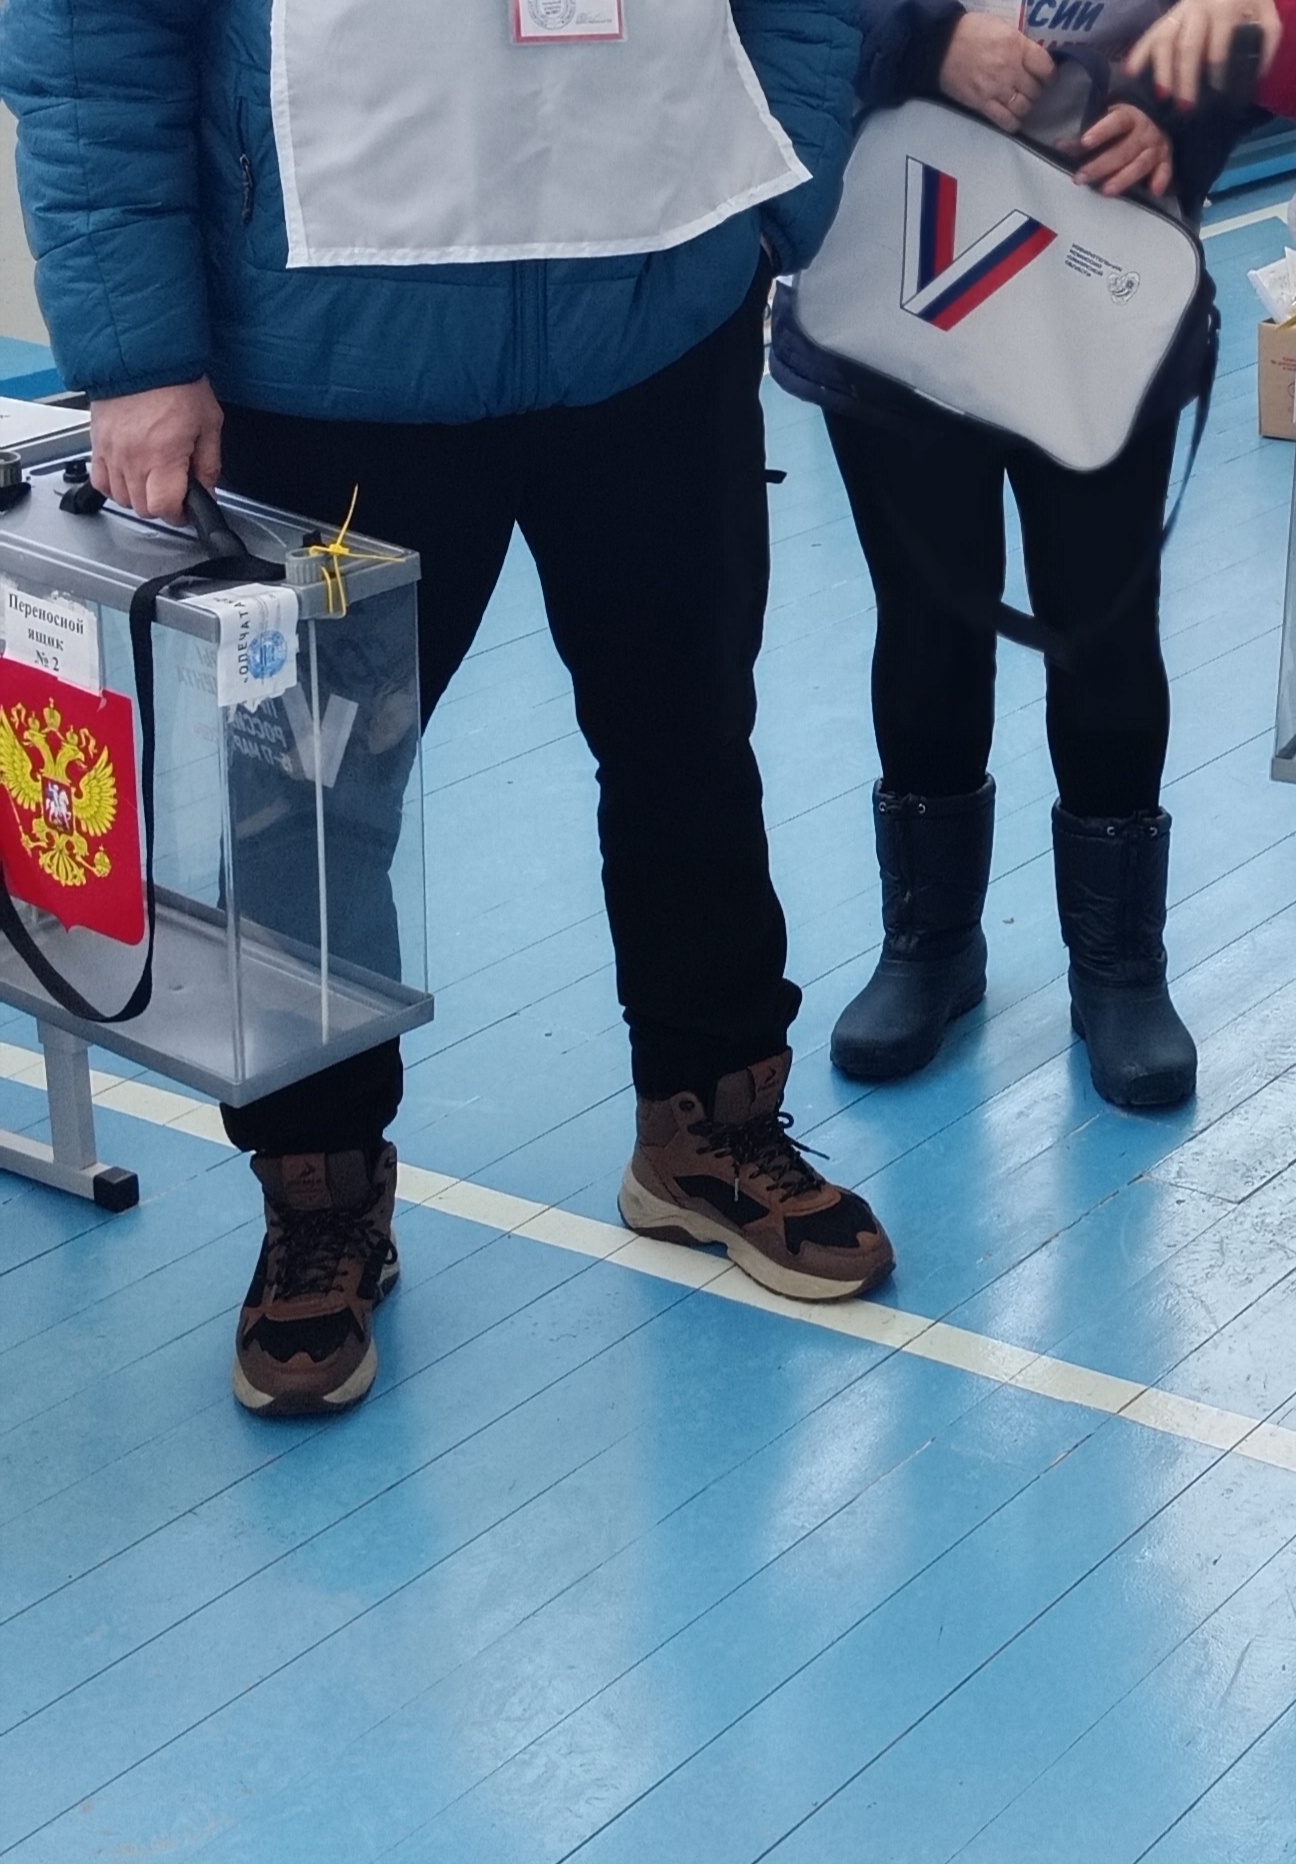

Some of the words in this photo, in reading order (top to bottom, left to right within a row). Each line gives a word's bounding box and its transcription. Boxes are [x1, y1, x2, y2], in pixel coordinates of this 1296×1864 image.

[8, 593, 84, 635] Переносной
[27, 628, 64, 651] ящик
[52, 656, 60, 672] 2
